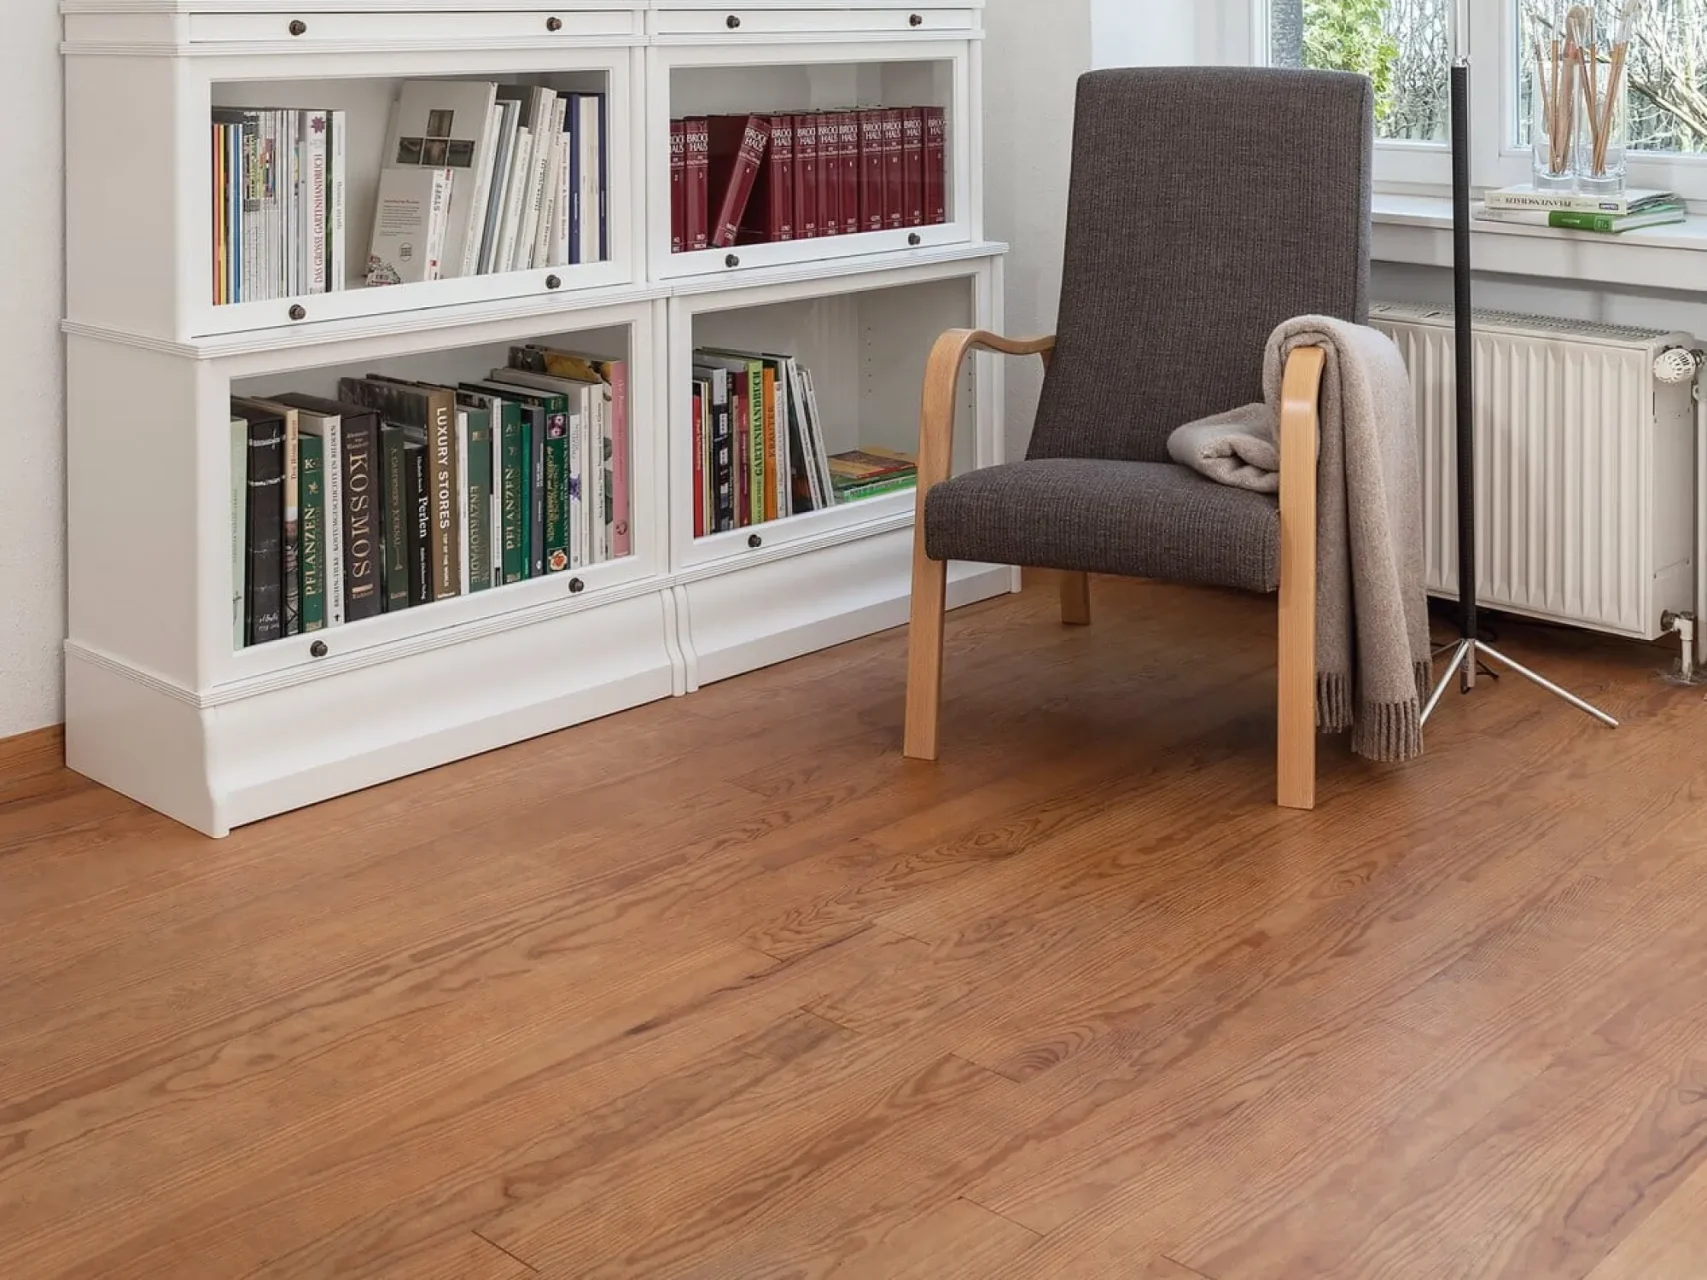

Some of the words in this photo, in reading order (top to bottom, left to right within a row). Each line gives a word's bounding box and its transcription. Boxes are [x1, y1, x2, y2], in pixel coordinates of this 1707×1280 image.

[436, 406, 449, 466] LUXURY
[752, 371, 763, 476] GARTENHANDBUCH
[349, 450, 372, 579] KOSMOS
[418, 495, 428, 539] Perlen
[438, 471, 450, 529] STORES
